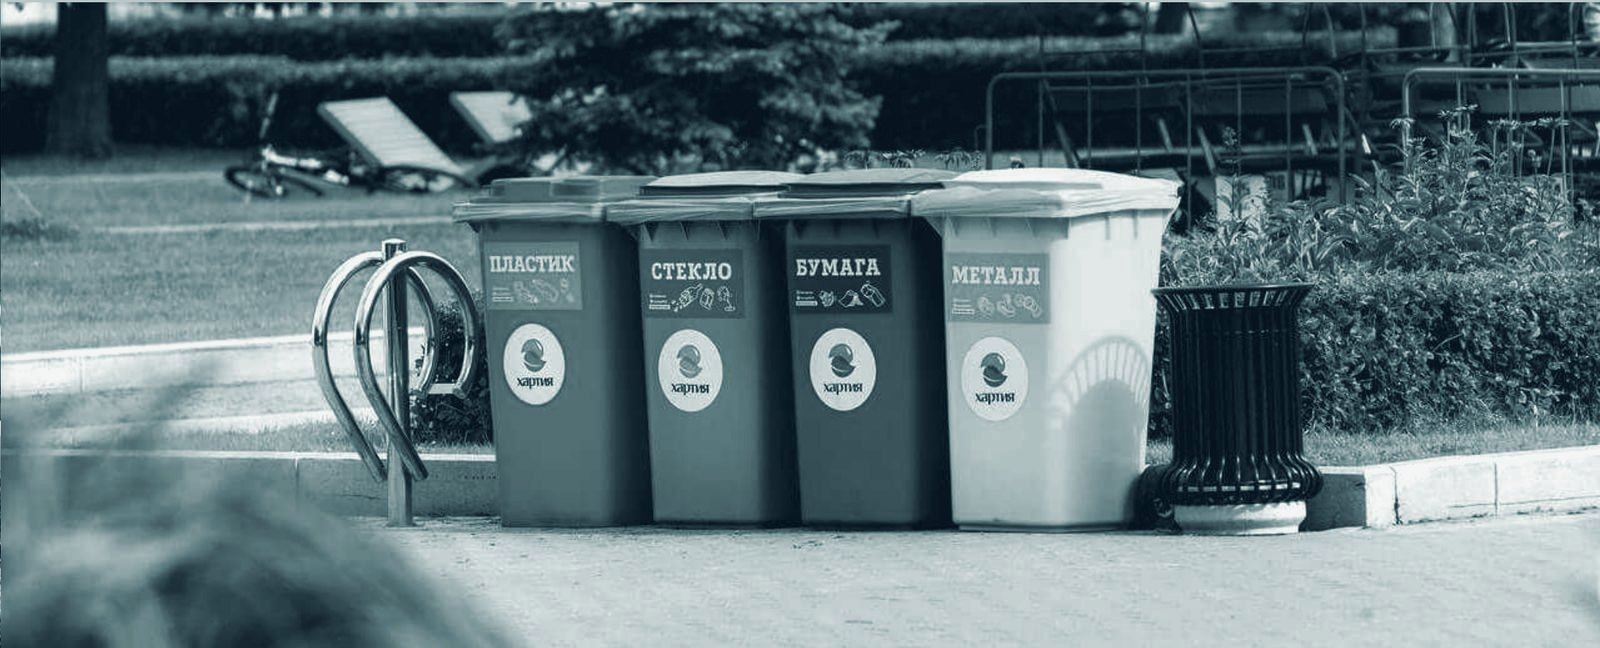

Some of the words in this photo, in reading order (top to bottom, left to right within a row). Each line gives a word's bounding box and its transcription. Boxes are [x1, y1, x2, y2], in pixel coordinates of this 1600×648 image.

[489, 255, 575, 273] ПЛАСТИК
[651, 262, 732, 280] СТЕКЛО
[796, 258, 881, 276] БУМАГА
[952, 266, 1040, 285] МЕТАЛЛ
[517, 377, 553, 389] хартия
[671, 383, 709, 395] хартия
[823, 383, 863, 395] хартия
[975, 392, 1015, 405] хартия
